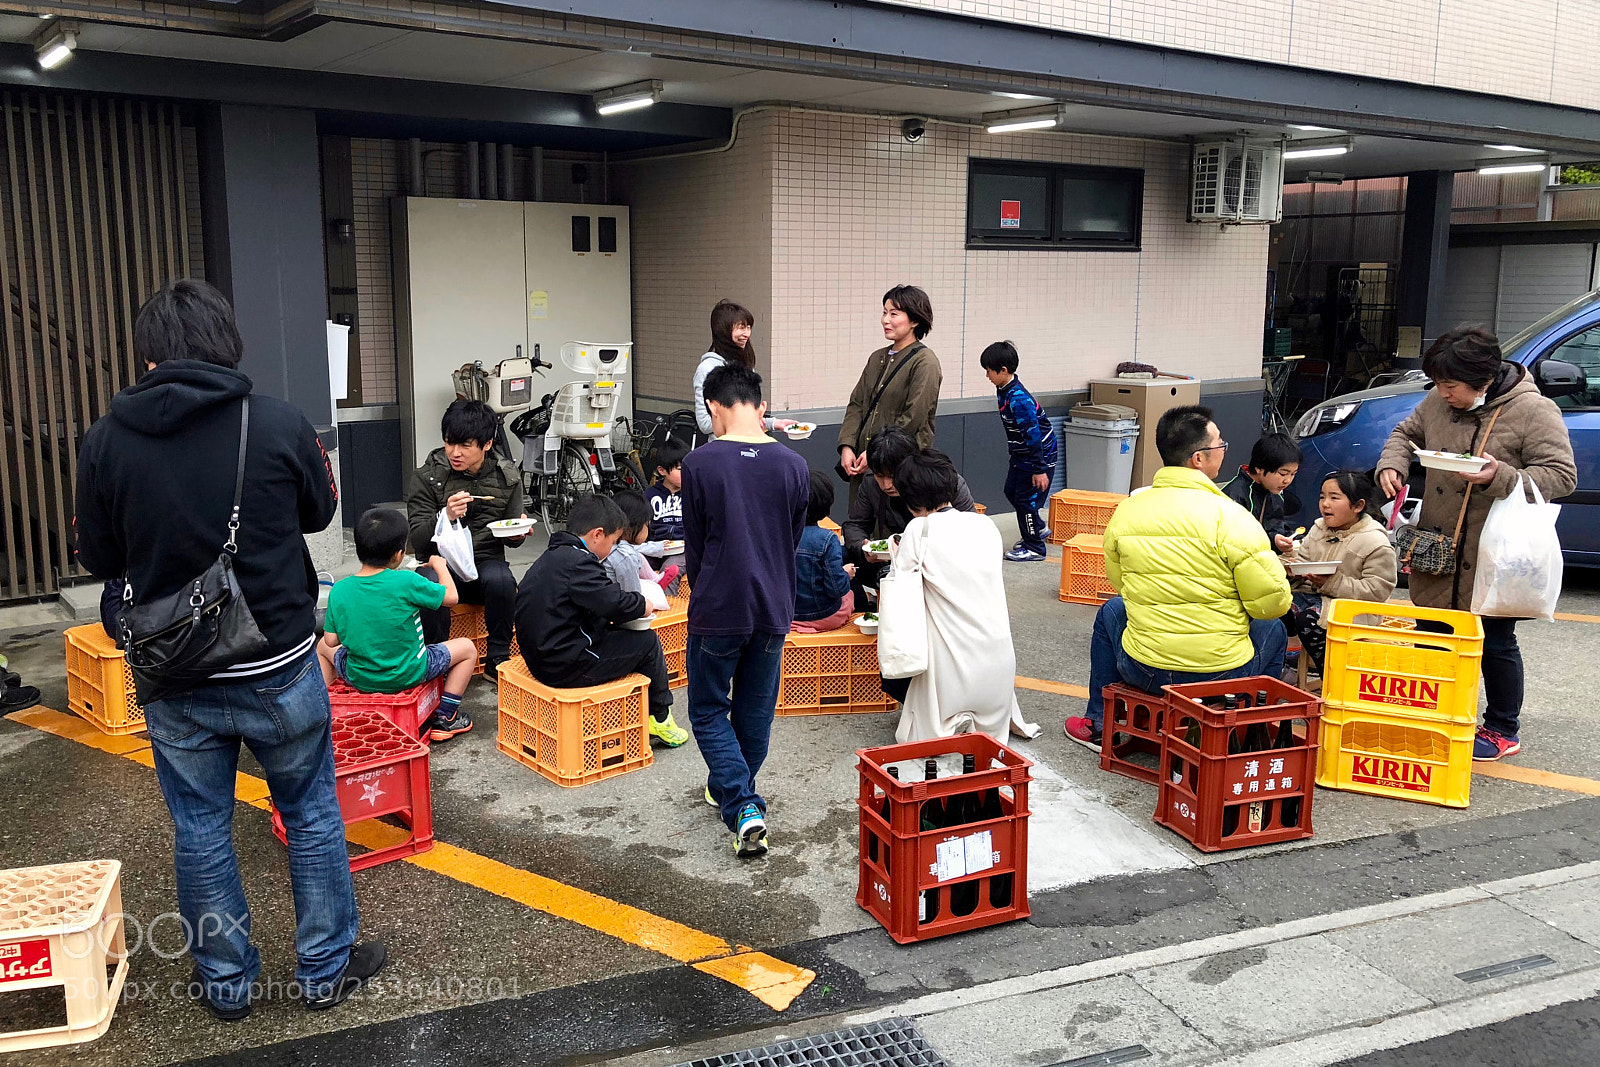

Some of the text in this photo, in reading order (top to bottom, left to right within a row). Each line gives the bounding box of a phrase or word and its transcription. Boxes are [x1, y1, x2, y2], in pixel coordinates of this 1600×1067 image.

[1359, 673, 1440, 703] KIRIN
[1382, 697, 1412, 706] キリンビール
[1244, 757, 1285, 778] 清酒
[1352, 755, 1432, 786] KIRIN
[1232, 776, 1292, 795] 専用通箱
[1375, 779, 1405, 788] キリンビール
